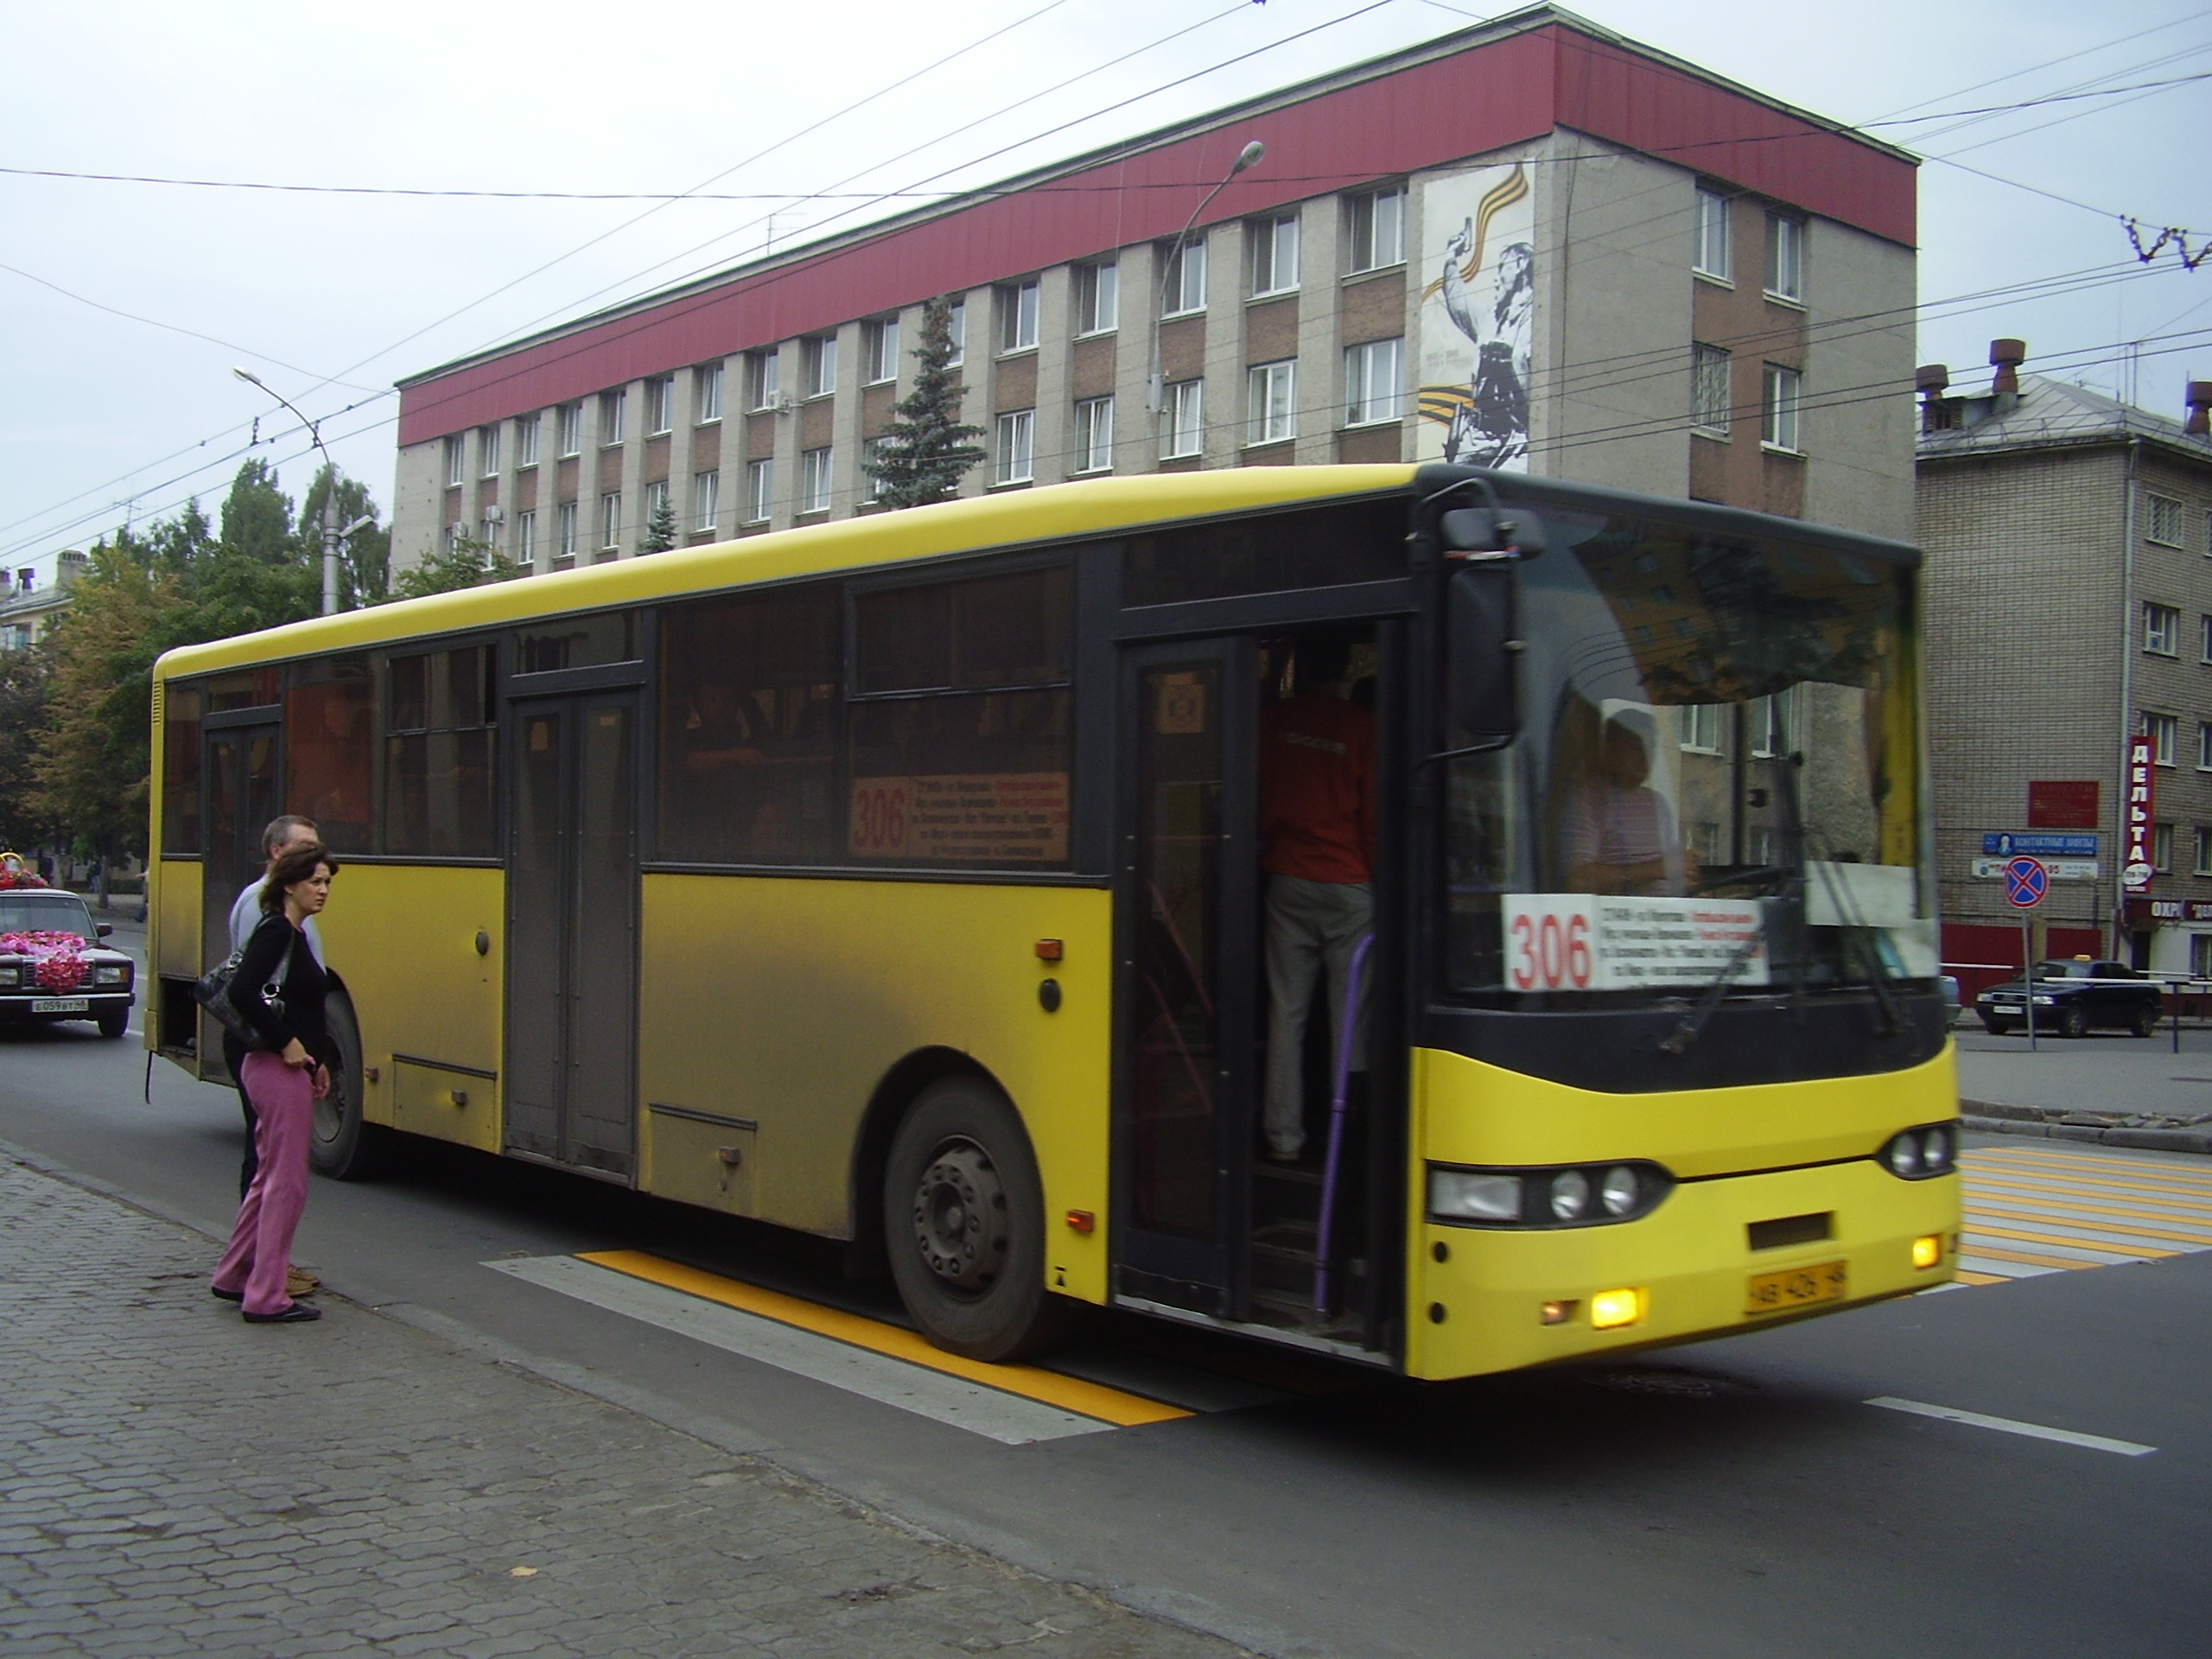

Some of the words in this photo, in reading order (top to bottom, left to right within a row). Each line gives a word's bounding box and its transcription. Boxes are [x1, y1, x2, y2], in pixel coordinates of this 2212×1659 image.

[852, 788, 906, 849] 306
[2129, 745, 2148, 861] ДЕЛЬТА
[1511, 913, 1592, 990] 306
